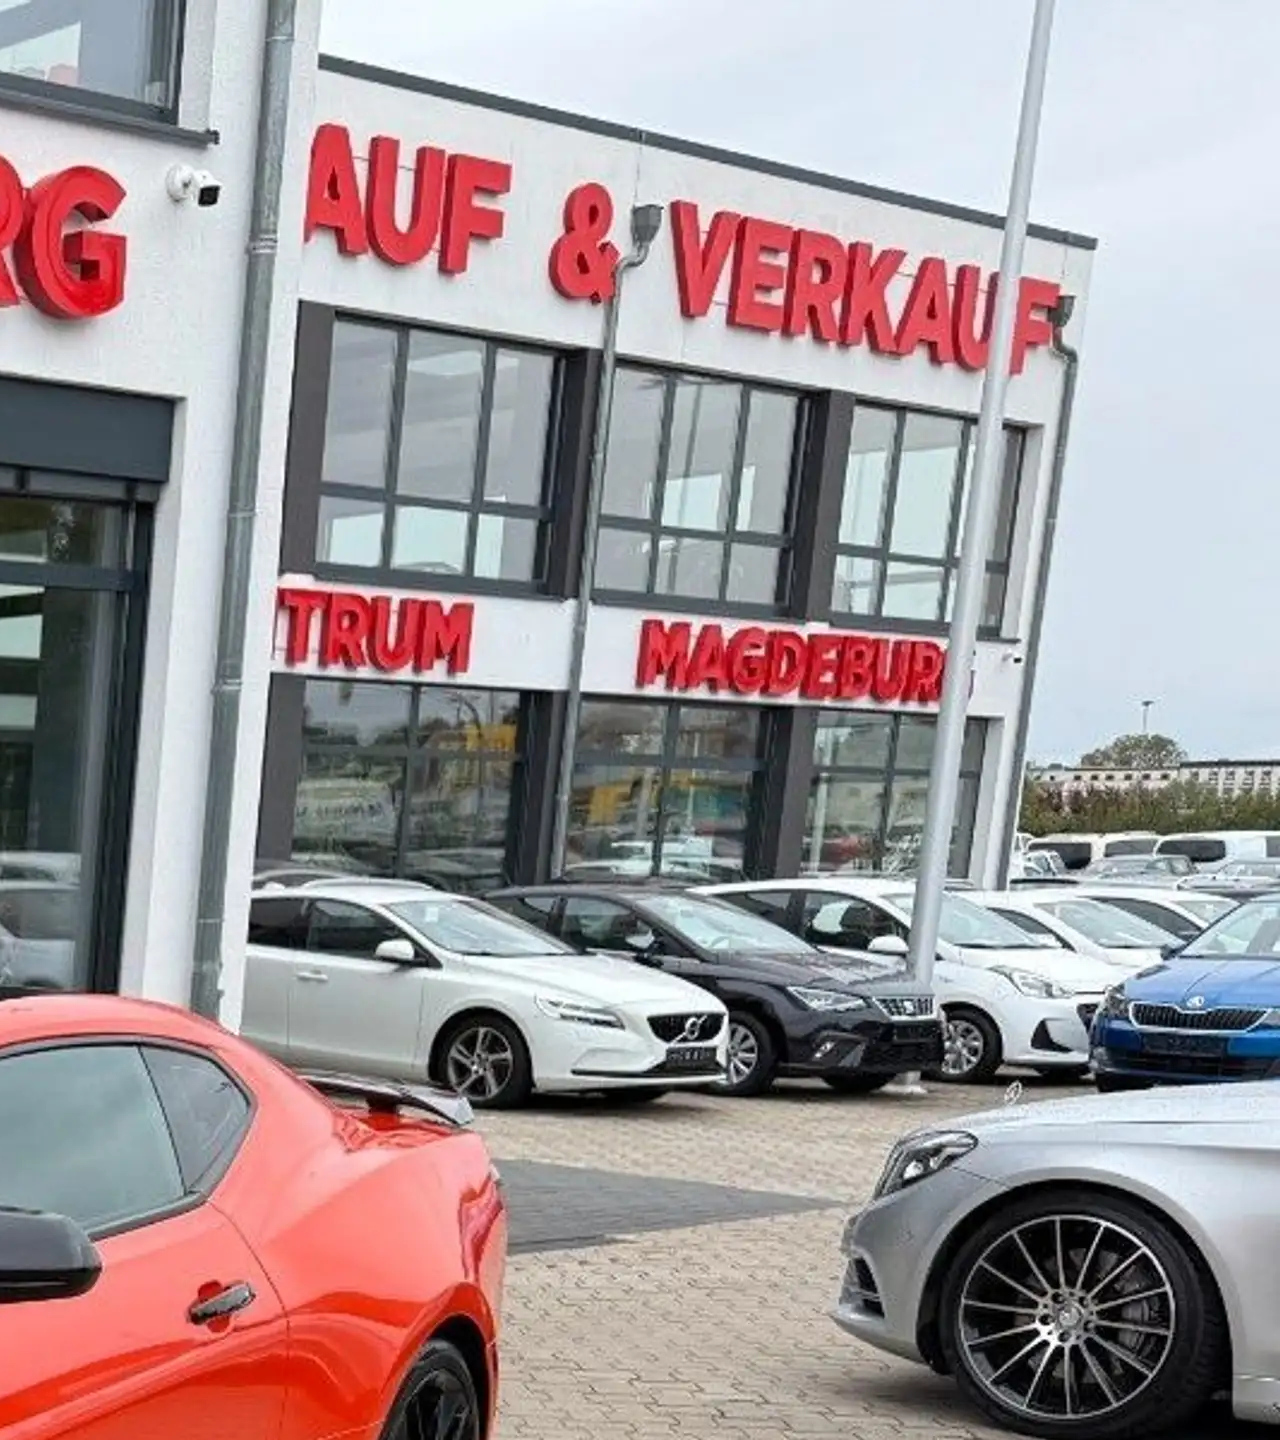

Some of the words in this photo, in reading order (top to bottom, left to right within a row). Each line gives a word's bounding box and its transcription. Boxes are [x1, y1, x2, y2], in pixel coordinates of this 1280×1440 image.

[304, 123, 512, 273] AUF
[550, 183, 620, 303] &
[671, 201, 1062, 376] VERKAUF
[636, 619, 947, 703] MAGDEBUR
